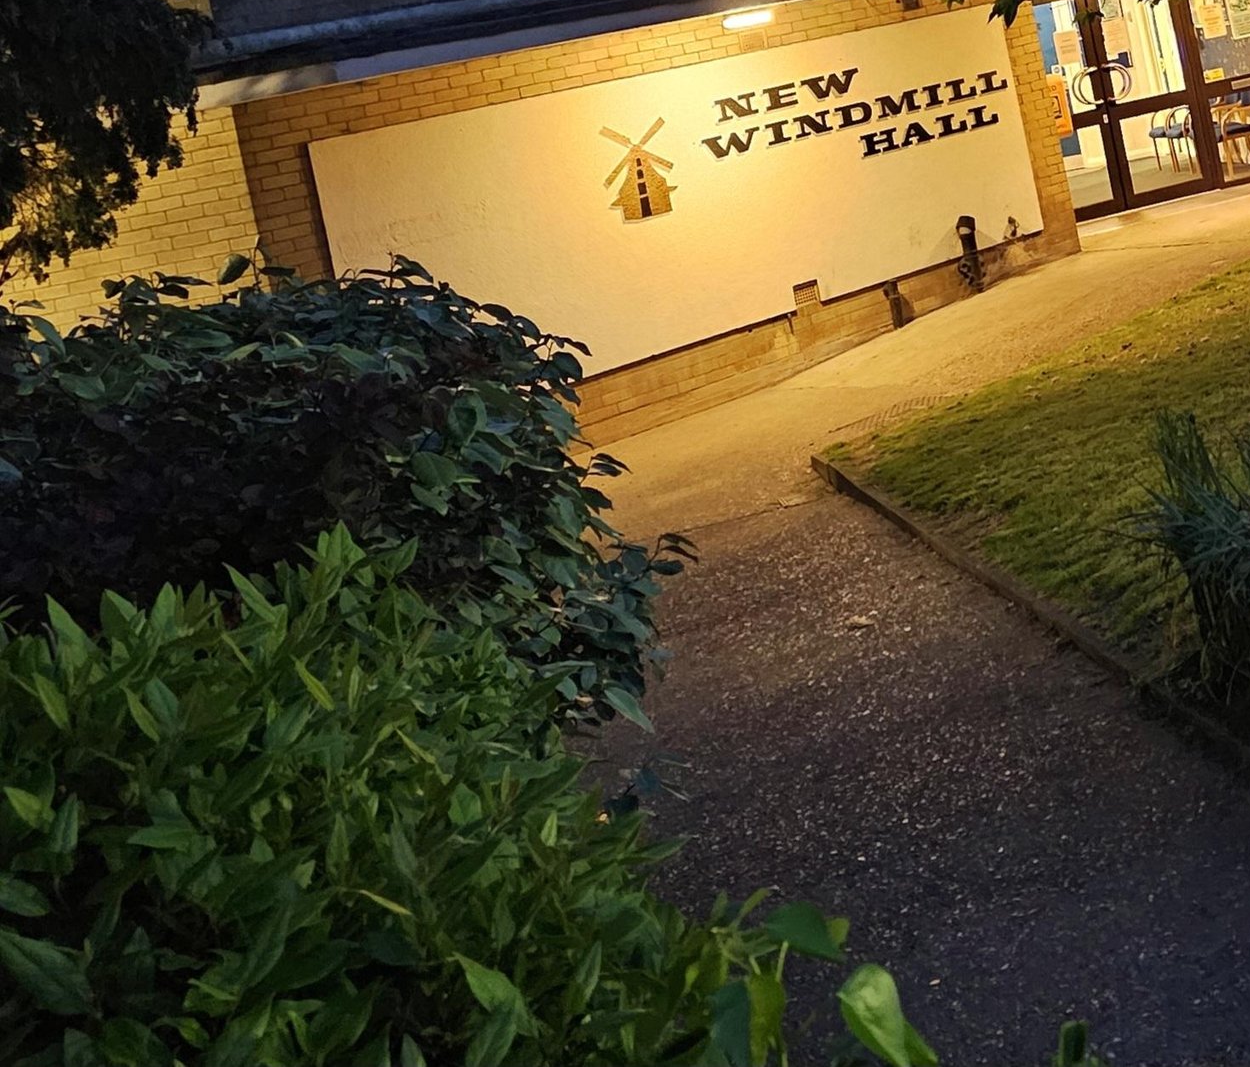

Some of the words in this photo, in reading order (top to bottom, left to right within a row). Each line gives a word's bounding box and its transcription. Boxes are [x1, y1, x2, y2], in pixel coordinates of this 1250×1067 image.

[701, 70, 1008, 160] WINDMILL
[714, 68, 859, 123] NEW
[860, 105, 1000, 158] HALL
